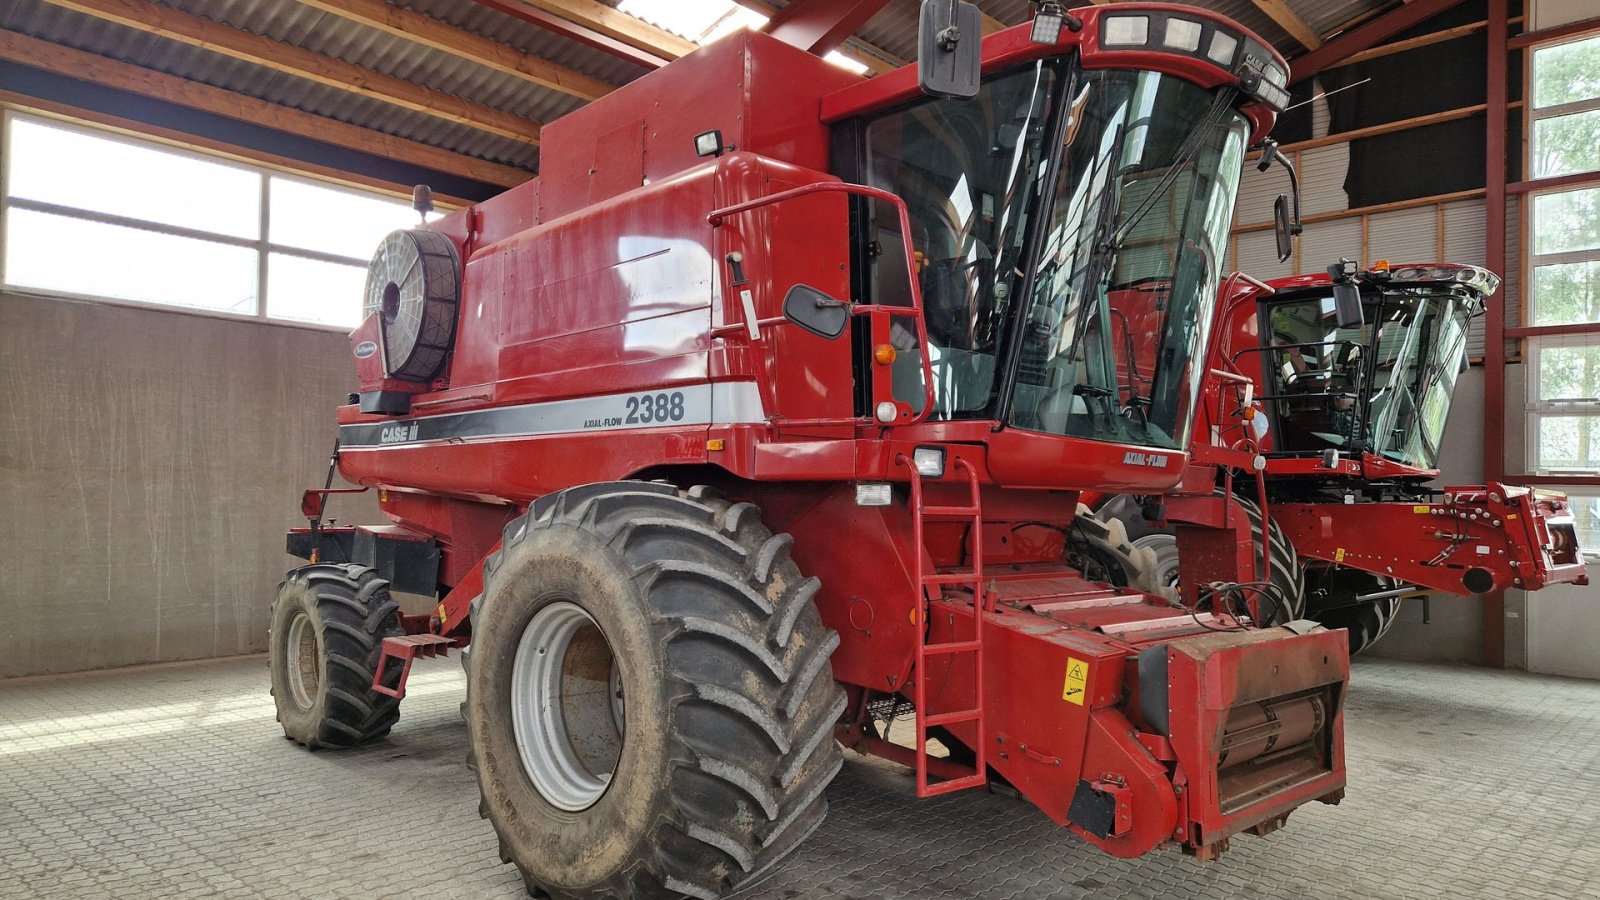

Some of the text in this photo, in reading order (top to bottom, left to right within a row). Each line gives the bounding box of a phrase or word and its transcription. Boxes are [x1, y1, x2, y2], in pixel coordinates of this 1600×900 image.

[583, 391, 685, 429] AXIAL-FLOW 2388
[381, 426, 408, 443] CASE
[1122, 451, 1168, 468] AXIAL-FLOW
